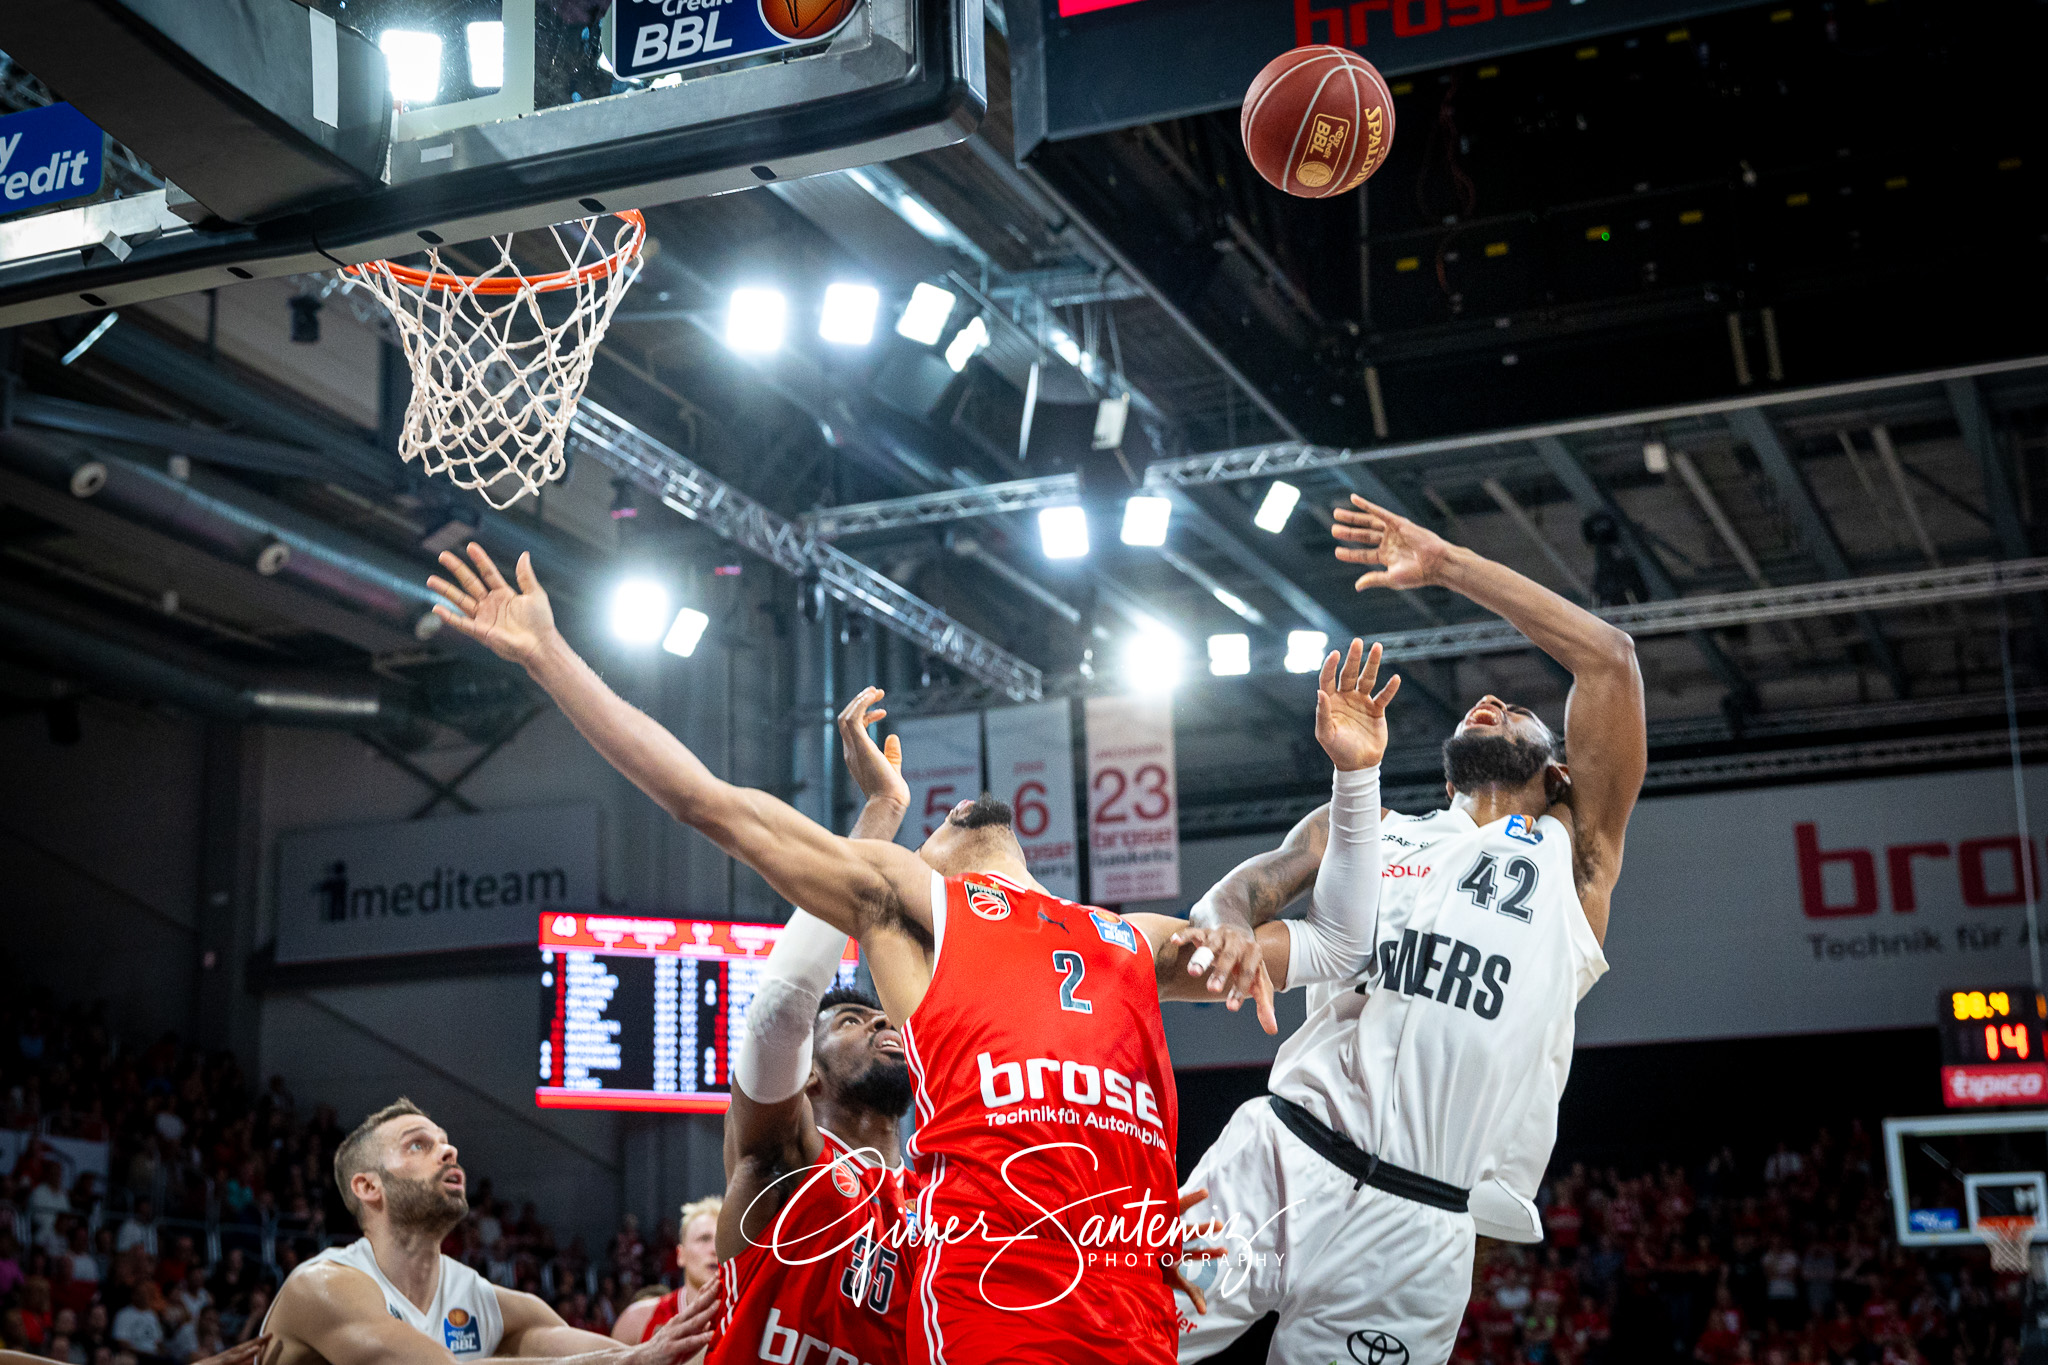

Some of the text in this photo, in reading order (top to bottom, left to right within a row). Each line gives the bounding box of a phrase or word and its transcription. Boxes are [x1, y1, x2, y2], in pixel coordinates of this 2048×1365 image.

[661, 0, 733, 17] Cre
[631, 10, 733, 68] BBL
[1309, 120, 1331, 154] BBL
[1012, 780, 1050, 839] 6
[1093, 763, 1172, 824] 23
[1457, 851, 1539, 924] 42
[1793, 819, 2048, 920] bro
[1053, 950, 1093, 1014] 2
[1984, 1022, 2030, 1061] 14
[977, 1051, 1164, 1129] brose
[985, 1105, 1057, 1127] Technik
[840, 1235, 898, 1314] 35
